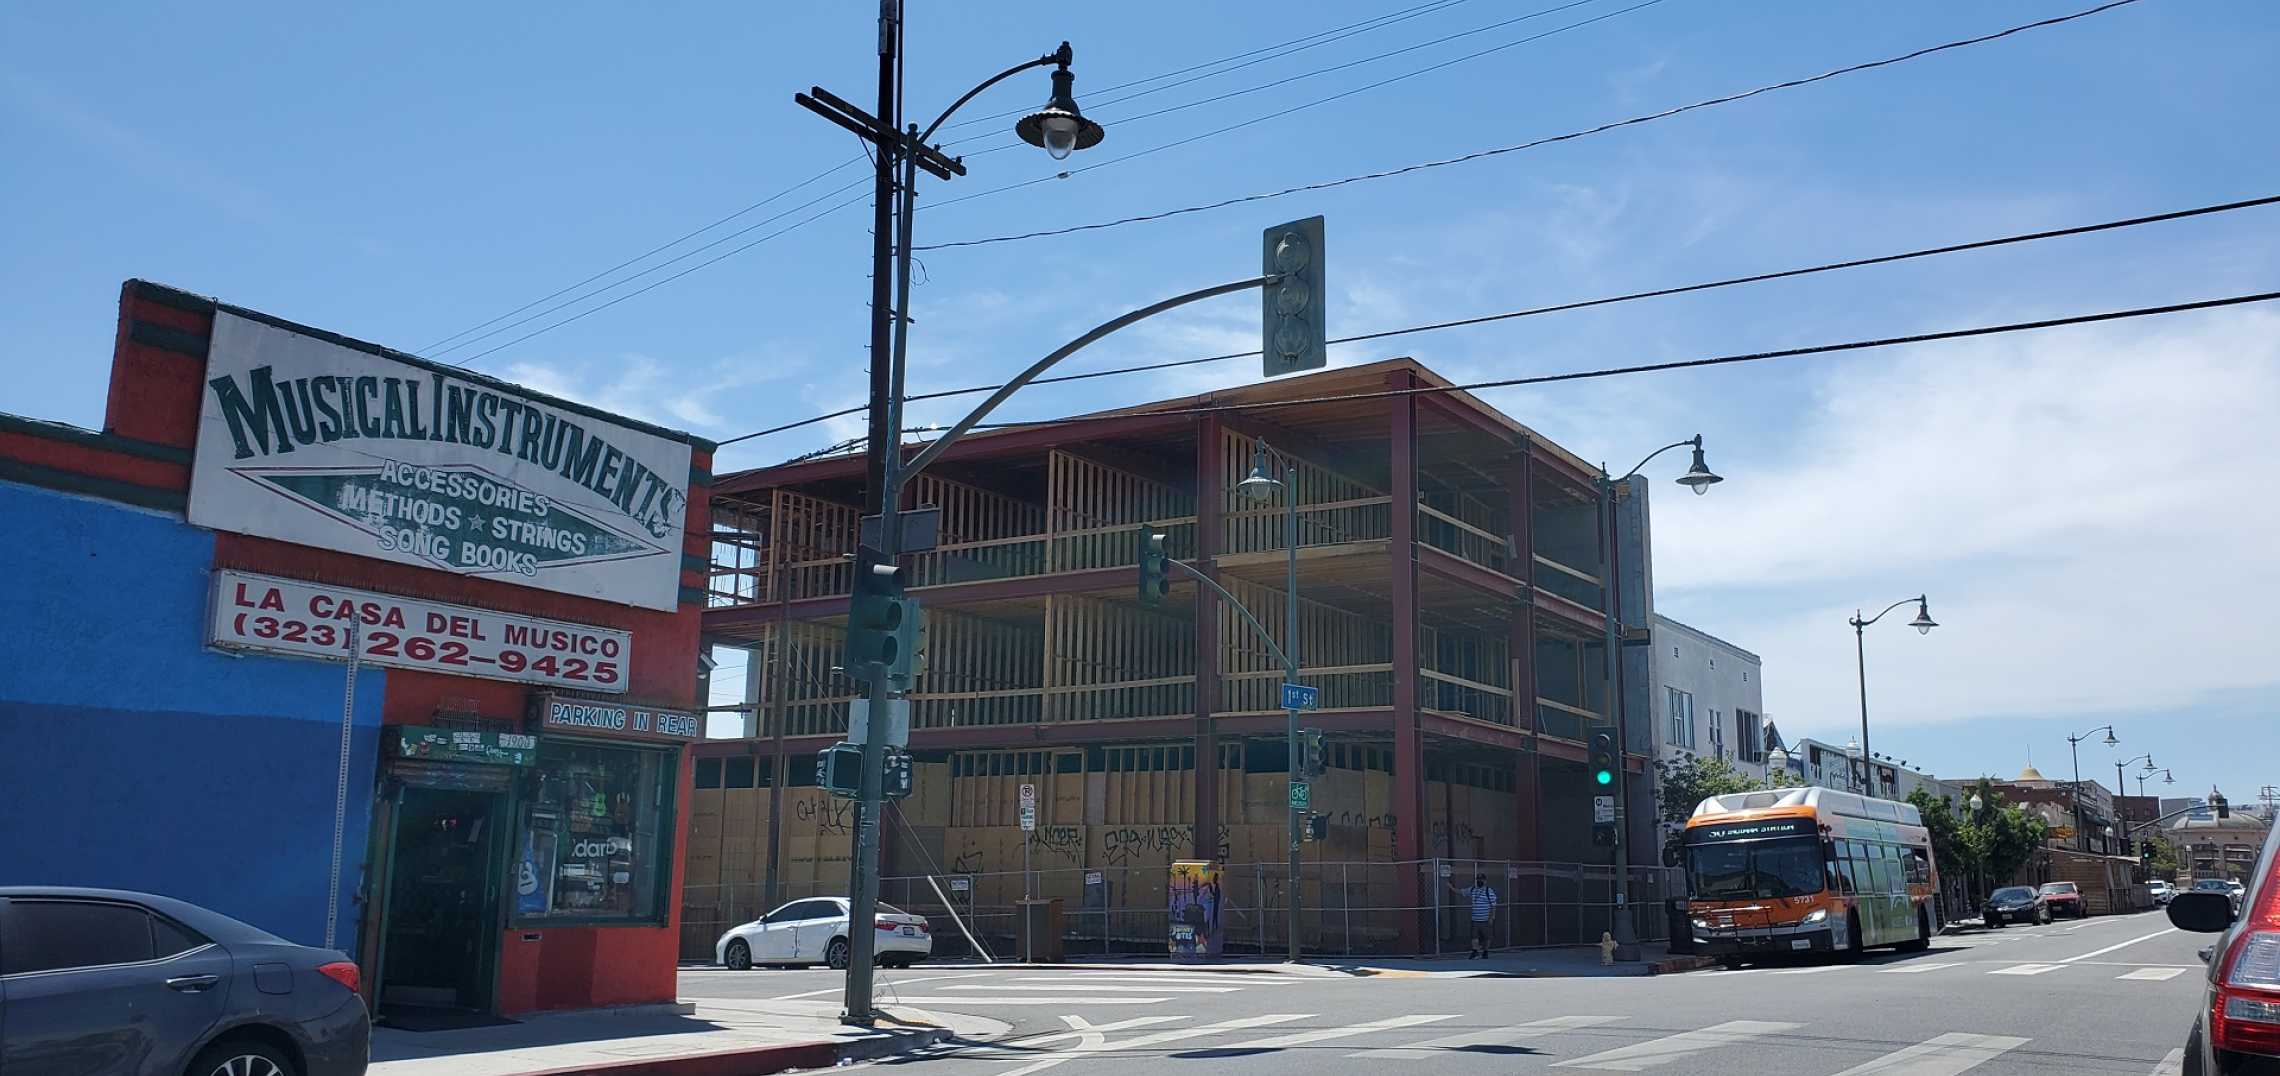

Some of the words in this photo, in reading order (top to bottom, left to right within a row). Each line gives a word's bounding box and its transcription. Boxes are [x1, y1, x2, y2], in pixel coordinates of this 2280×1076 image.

[209, 364, 428, 460] MUSICAL
[427, 373, 685, 539] INSTRUMENTS
[381, 459, 550, 517] ACCESSORIES
[337, 483, 462, 530] METHODS
[492, 516, 587, 556] STRINGS
[378, 525, 450, 561] SONG
[461, 541, 539, 577] BOOKS
[234, 583, 285, 613] LA
[309, 595, 406, 629] CASA
[426, 612, 487, 642] DEL
[504, 624, 620, 658] MUSICO
[550, 703, 626, 730] PARKING
[633, 711, 650, 732] IN
[657, 714, 698, 737] REAR
[1287, 689, 1299, 704] 1st
[1303, 692, 1313, 705] St
